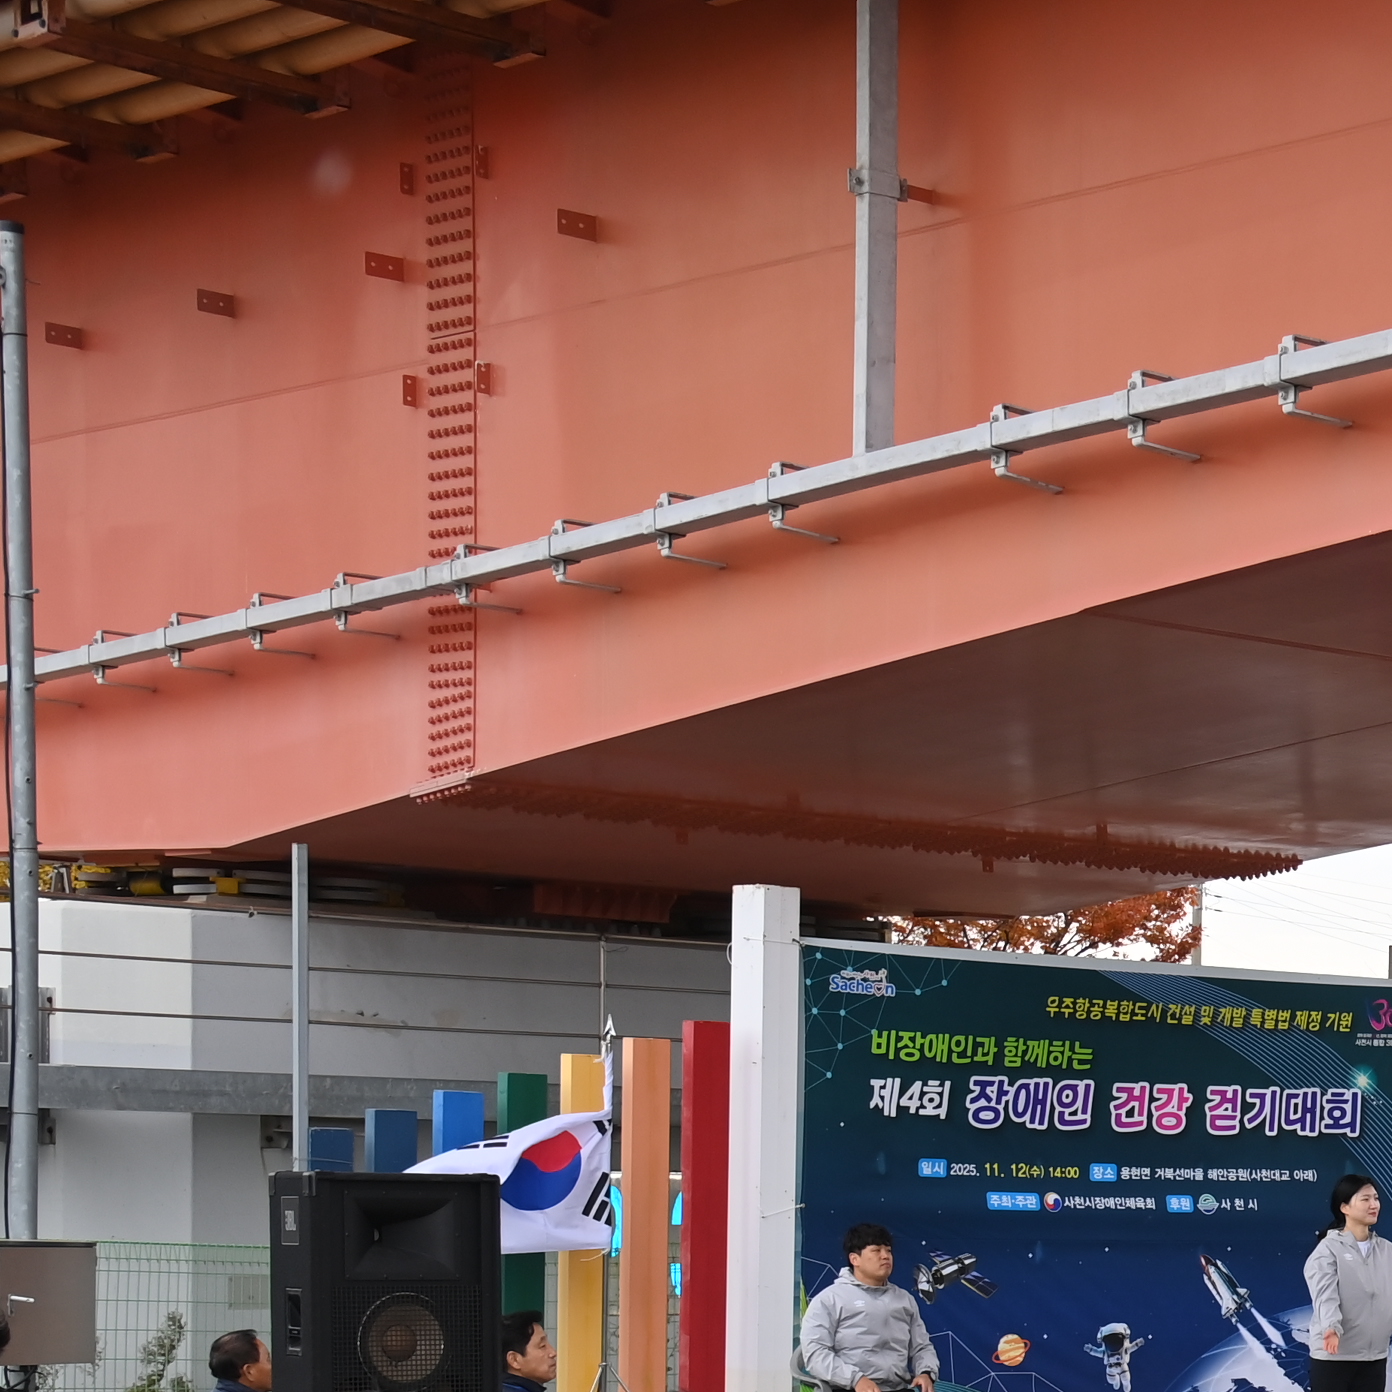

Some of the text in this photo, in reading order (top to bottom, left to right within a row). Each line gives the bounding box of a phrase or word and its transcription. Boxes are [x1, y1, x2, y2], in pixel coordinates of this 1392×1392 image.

[1046, 997, 1353, 1032] 우주항공복합도시 건설 및 개발 특별법 제정 기원
[870, 1029, 1094, 1070] 비장애인과 함께하는
[869, 1075, 1362, 1137] 제4회 장애인 건강 걷기대회
[921, 1161, 1080, 1179] 일시 2025. 11. 12(수) 14:00
[1092, 1166, 1318, 1182] 장소 용현면 거북선마을 해안공원(사천대교 아래)
[1064, 1196, 1156, 1210] 사천시장애인체육회
[1169, 1197, 1191, 1211] 후원
